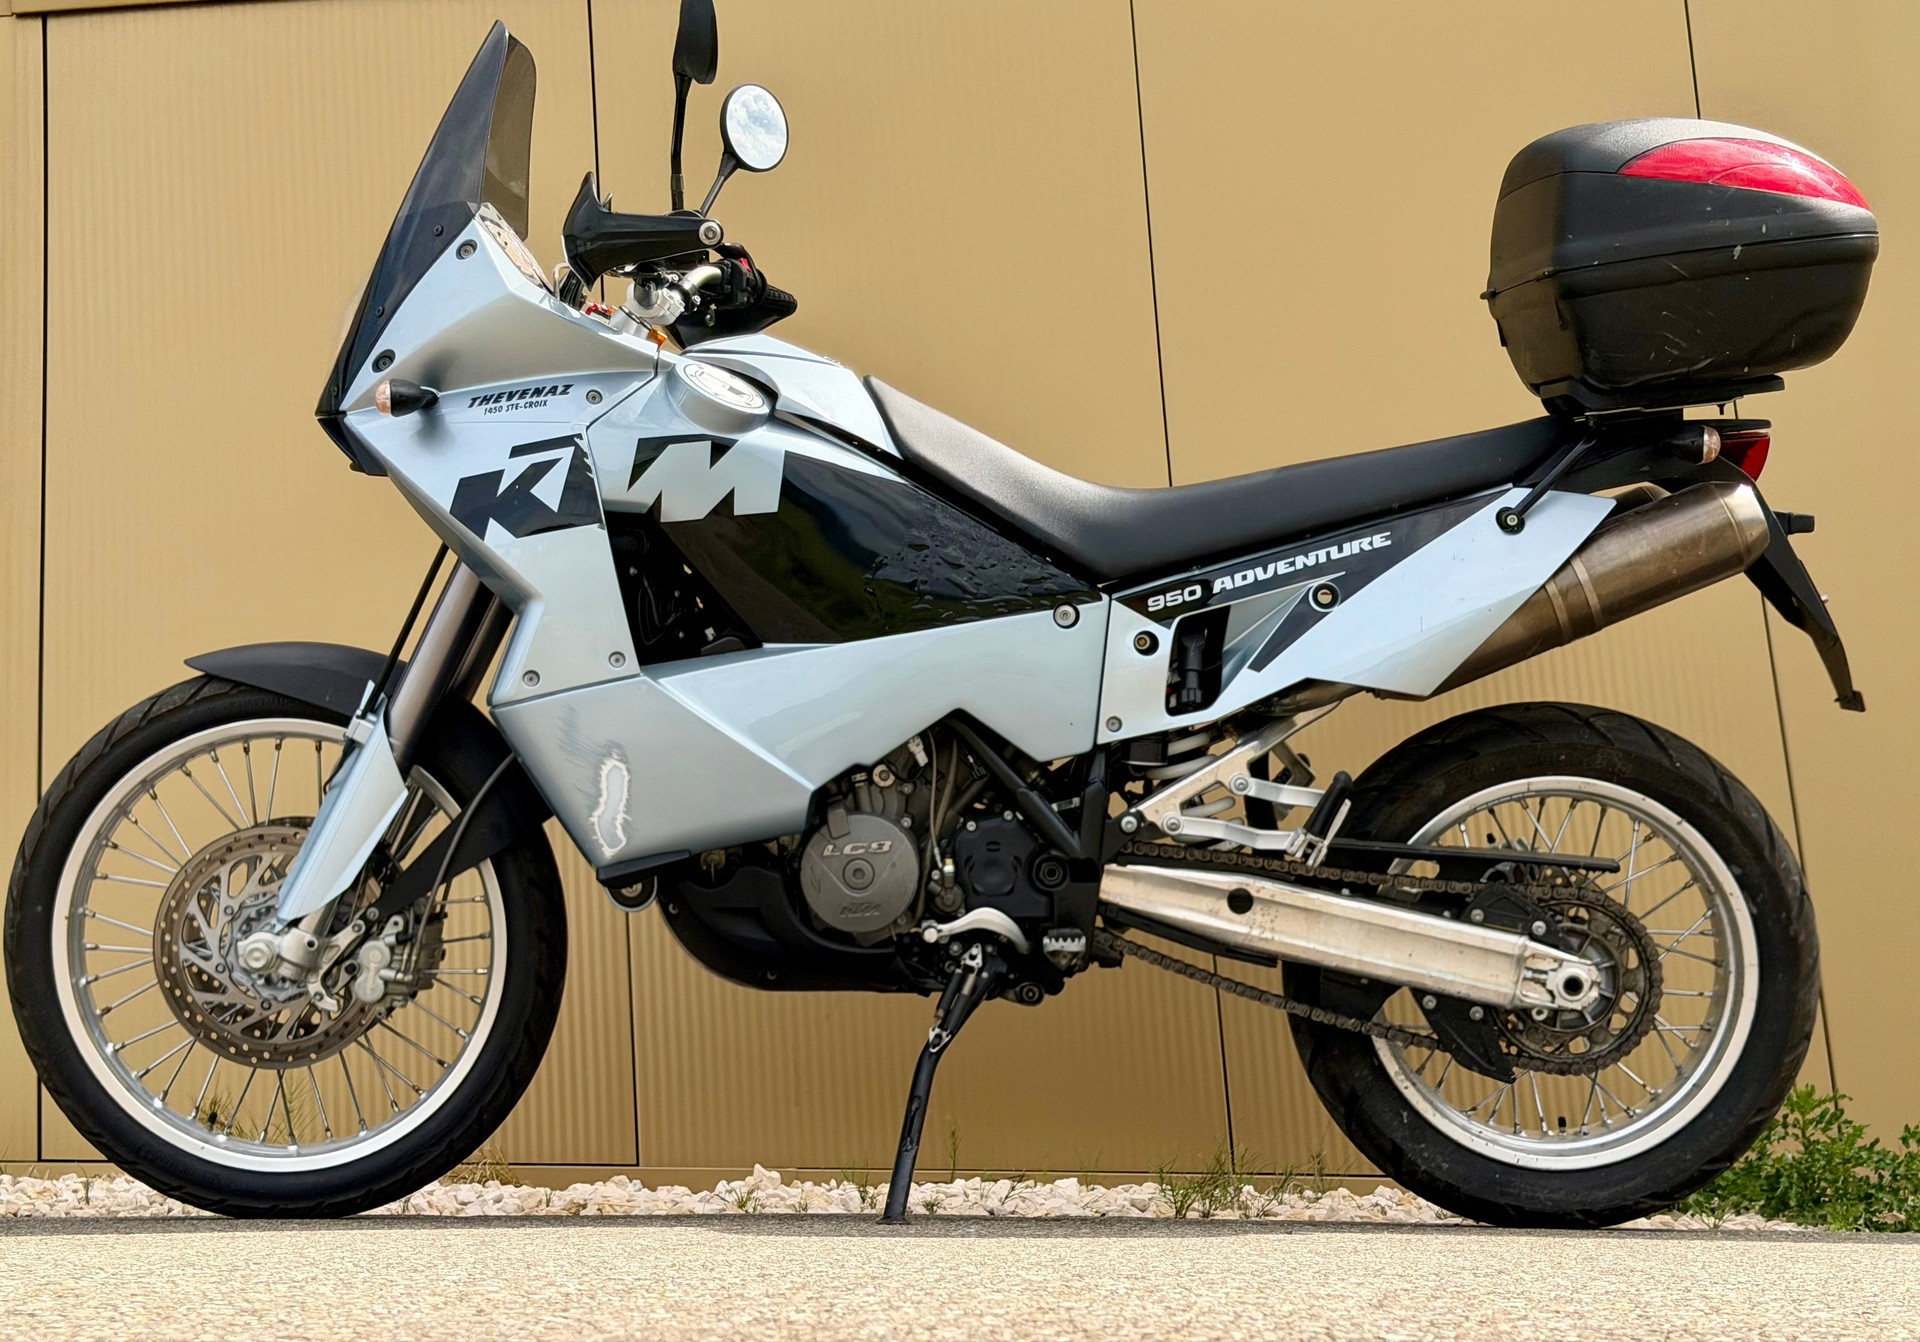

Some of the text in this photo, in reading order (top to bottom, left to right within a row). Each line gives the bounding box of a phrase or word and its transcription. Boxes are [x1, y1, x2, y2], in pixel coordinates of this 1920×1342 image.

[467, 384, 575, 409] THEVENAZ
[483, 399, 549, 416] 1450 STE-CROIX
[449, 432, 786, 543] KTM
[1147, 531, 1392, 612] 950 ADVENTURE
